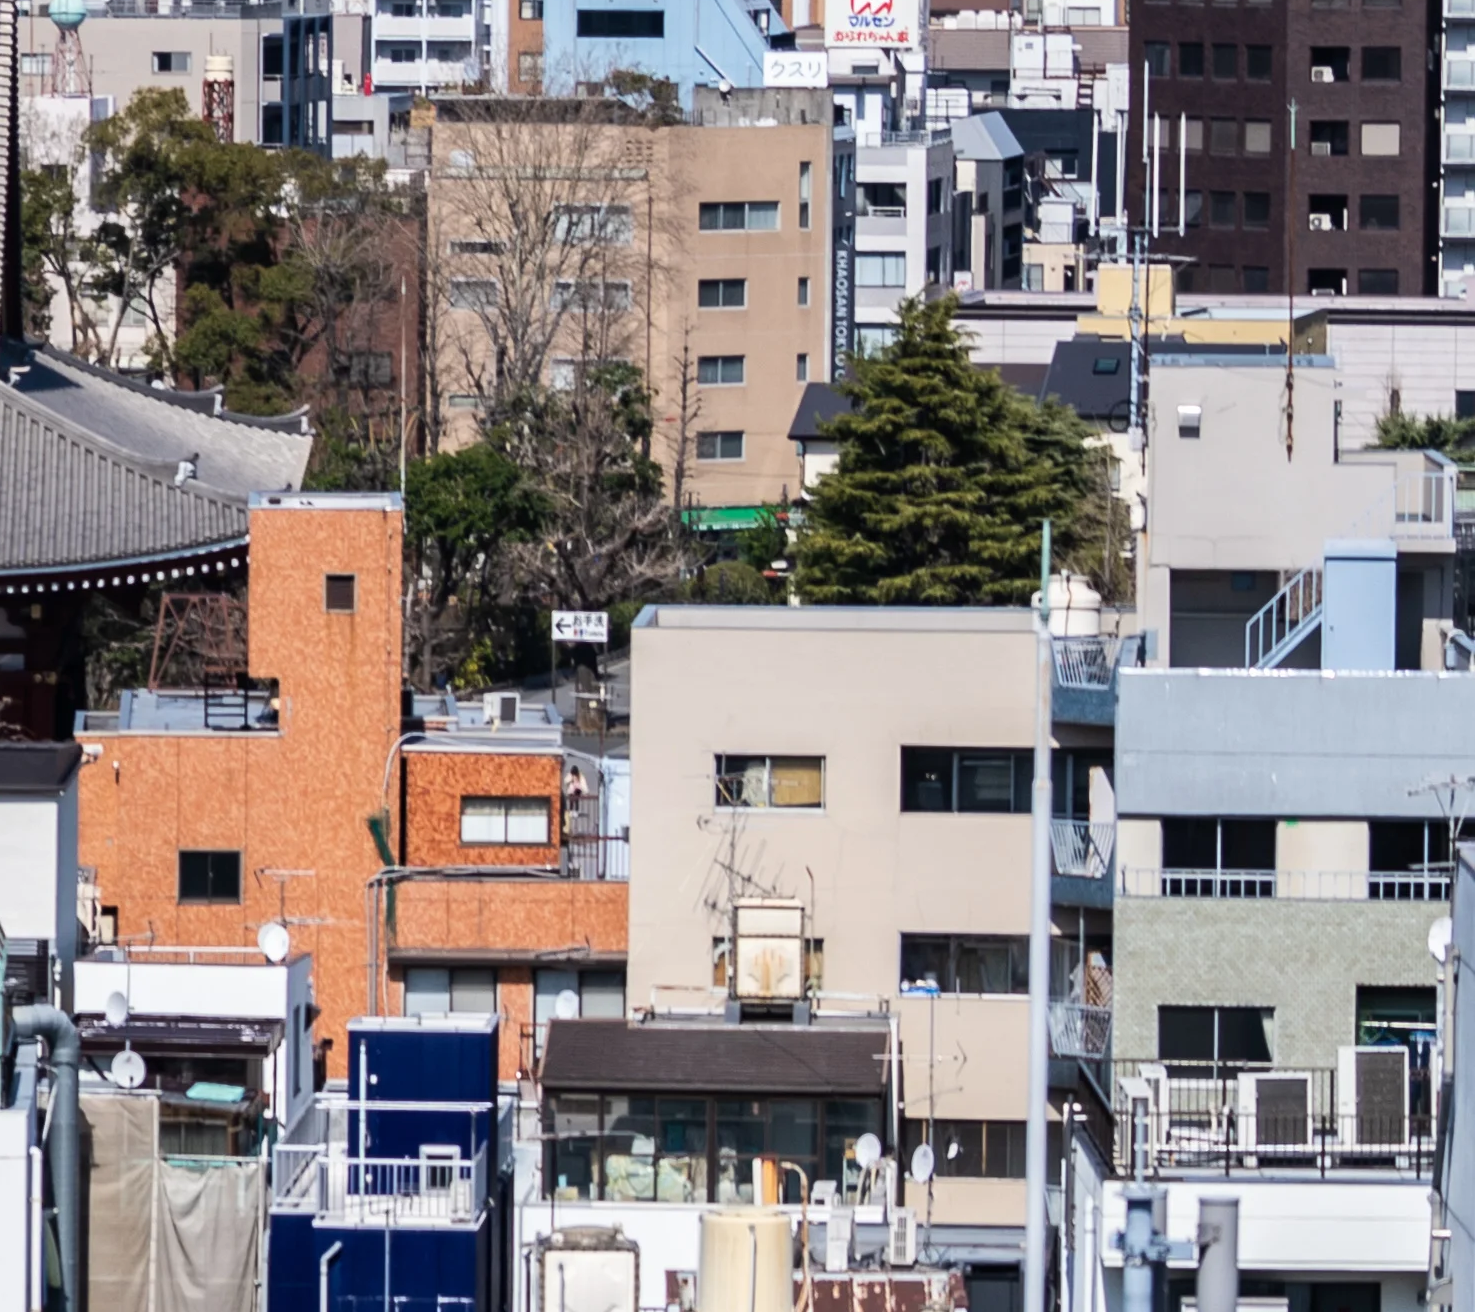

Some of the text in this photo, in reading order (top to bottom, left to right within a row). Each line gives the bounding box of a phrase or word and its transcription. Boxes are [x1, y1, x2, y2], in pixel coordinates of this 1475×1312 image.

[848, 15, 894, 27] マルセン
[771, 60, 821, 79] クスリ
[835, 250, 847, 318] KHAOSAN
